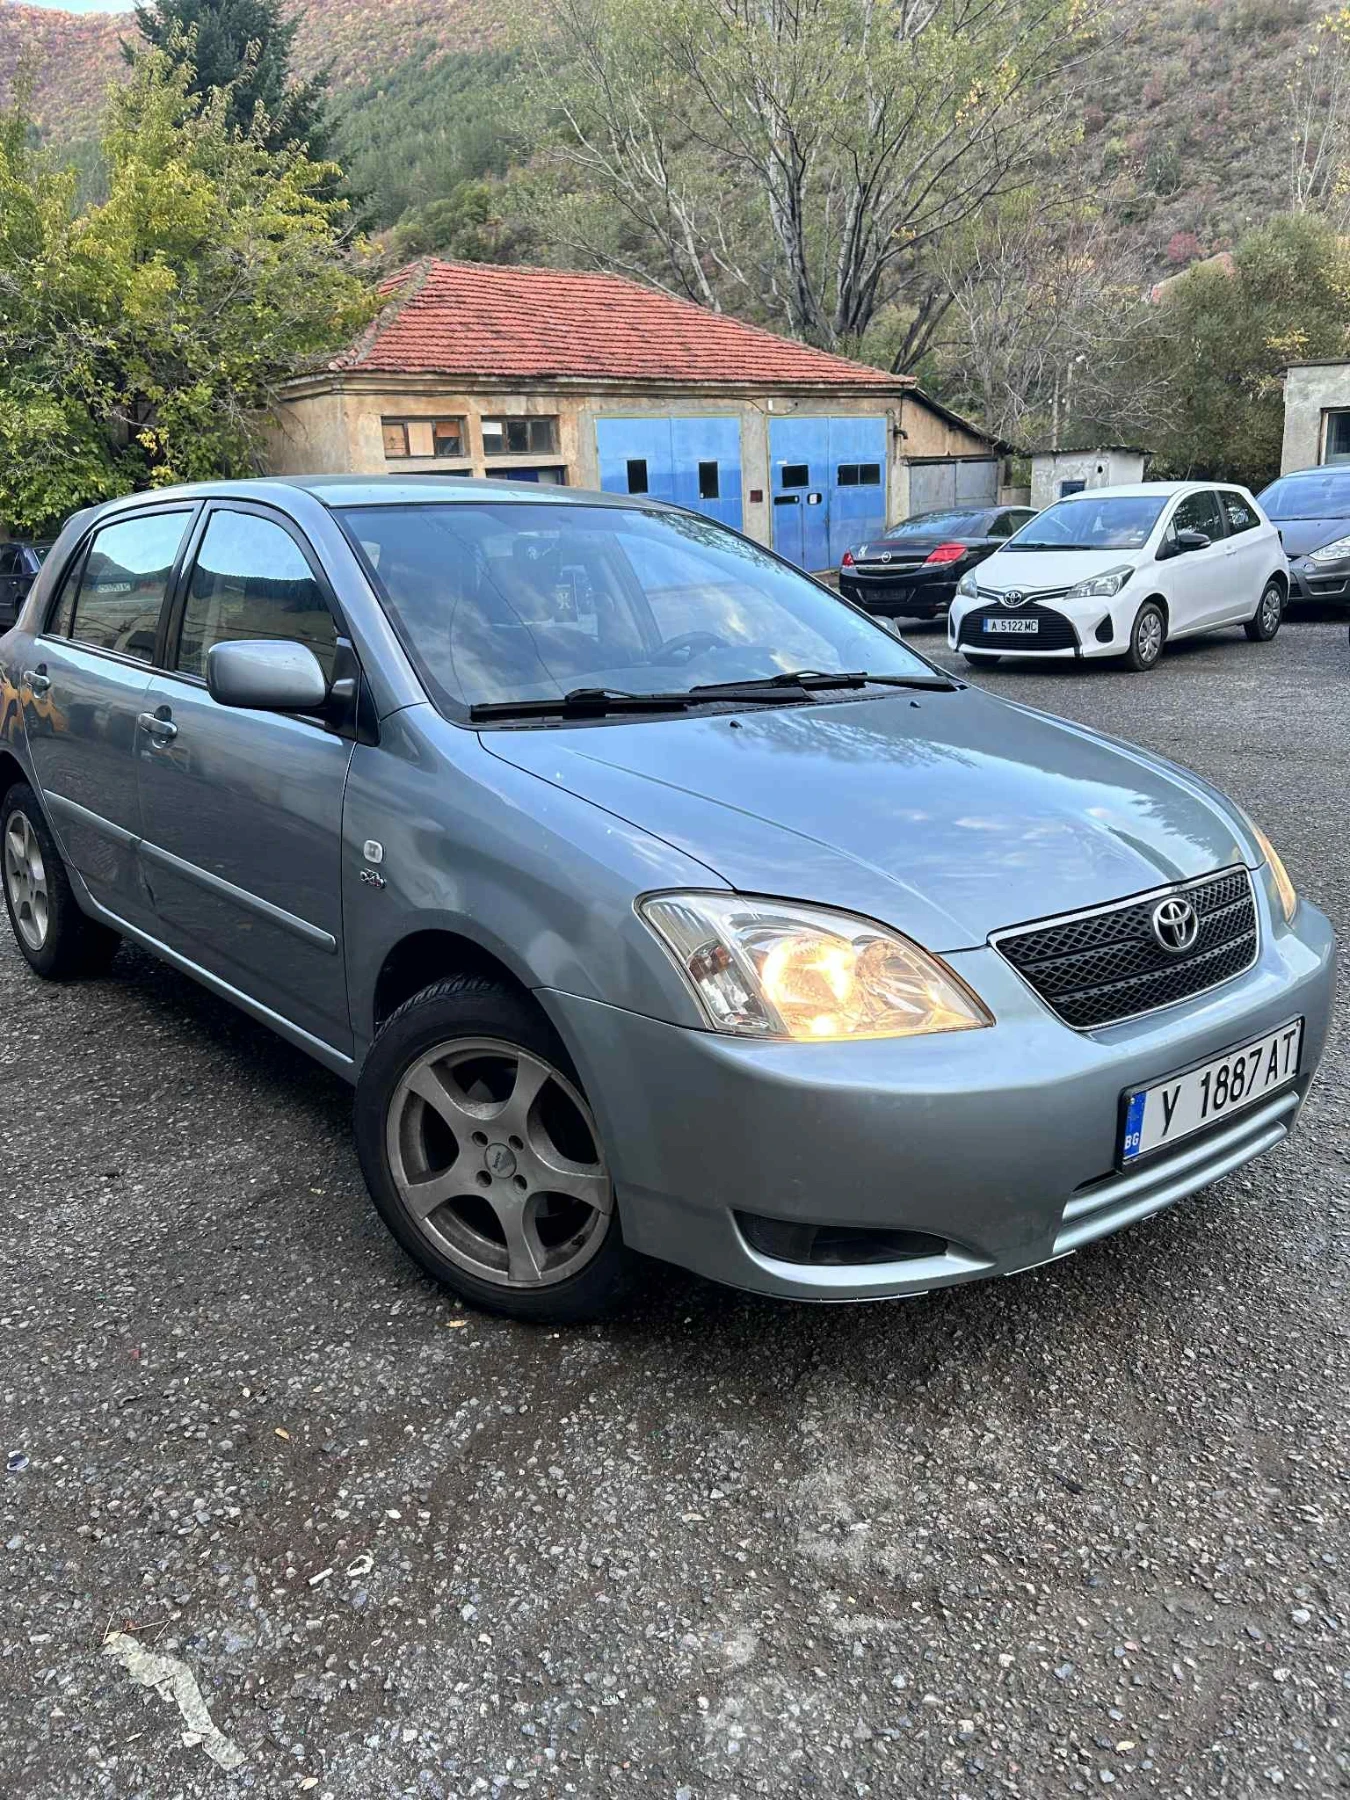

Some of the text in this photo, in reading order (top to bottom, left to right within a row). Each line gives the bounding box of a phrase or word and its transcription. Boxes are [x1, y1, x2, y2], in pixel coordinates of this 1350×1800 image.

[992, 621, 998, 631] A
[1001, 621, 1023, 631] 5122
[1025, 621, 1037, 631] MC
[1162, 1028, 1297, 1137] Y 1887 AT
[1125, 1132, 1139, 1149] BG
